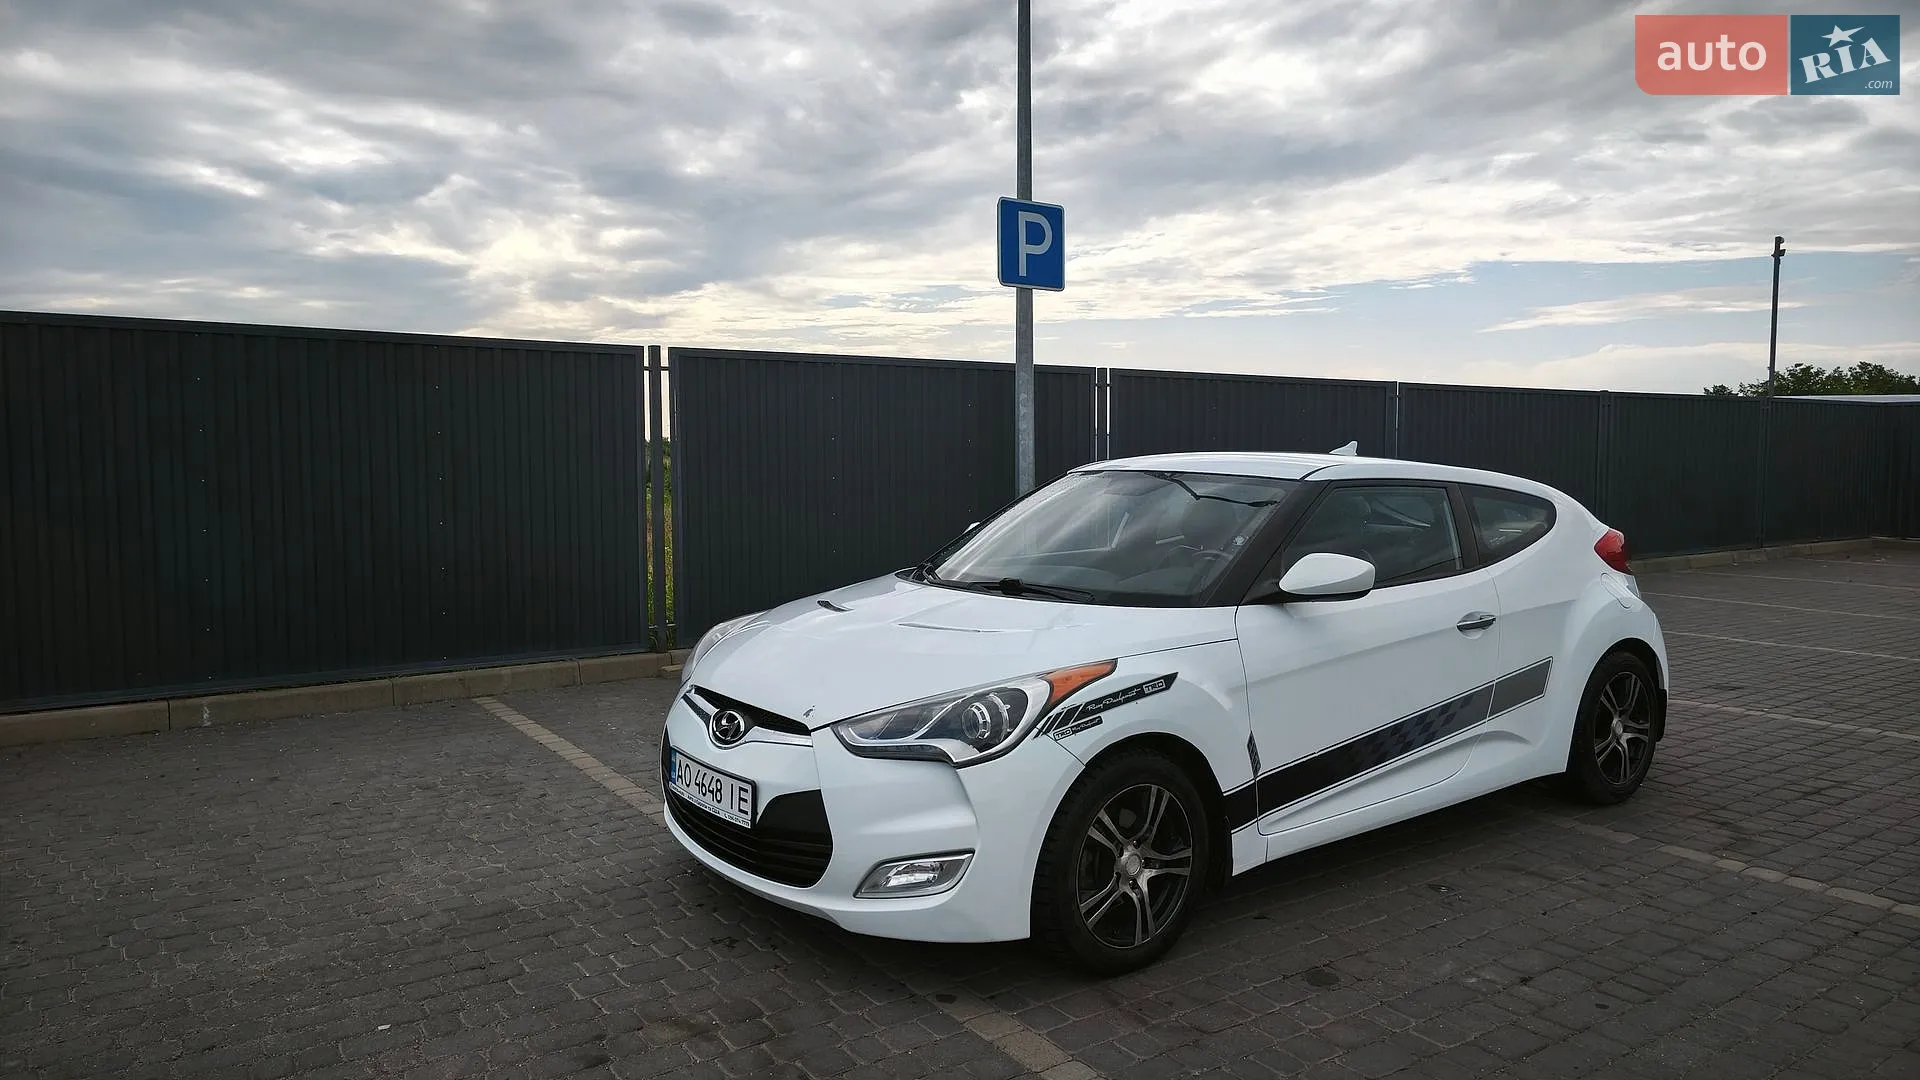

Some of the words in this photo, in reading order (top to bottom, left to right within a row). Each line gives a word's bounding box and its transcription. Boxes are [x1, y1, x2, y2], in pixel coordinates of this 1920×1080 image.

[1018, 210, 1053, 277] P
[677, 759, 692, 788] AO
[694, 768, 723, 804] 4648
[731, 783, 749, 816] IE
